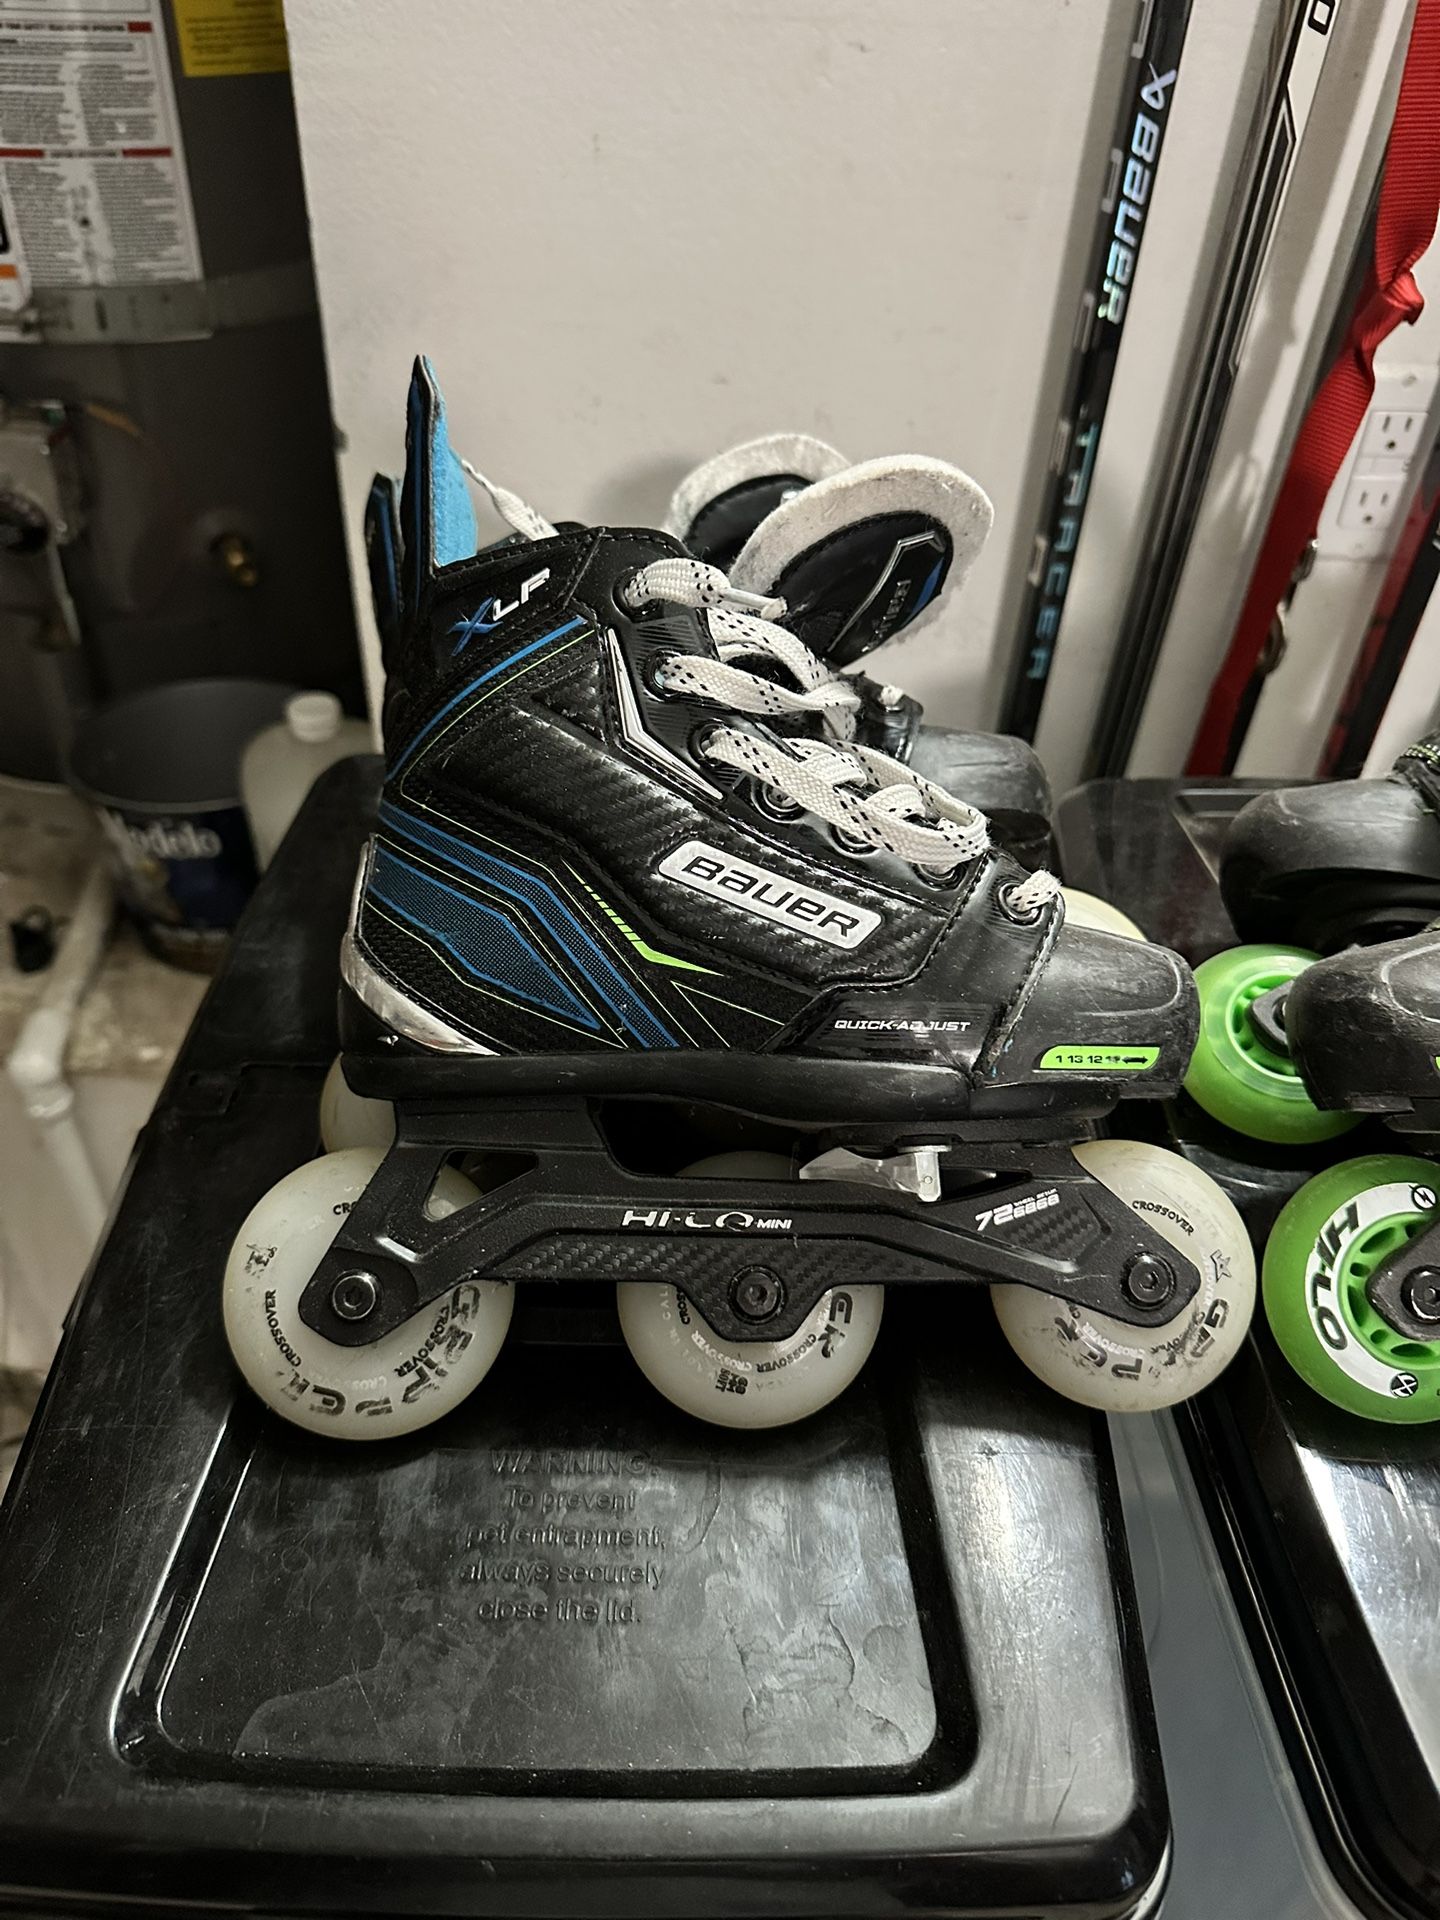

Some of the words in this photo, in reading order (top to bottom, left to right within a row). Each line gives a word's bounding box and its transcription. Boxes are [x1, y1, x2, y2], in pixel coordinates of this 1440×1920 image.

[1098, 112, 1160, 325] BAUER
[681, 854, 861, 937] BAUER
[834, 1020, 971, 1032] QUICK-ADJUST
[757, 1219, 792, 1230] MINI
[975, 1203, 1014, 1231] 72
[1132, 1200, 1195, 1236] CROSSOVER
[264, 1289, 302, 1367] CROSSOVER
[394, 1305, 450, 1378] CROSSOVER
[756, 1333, 817, 1373] CROSSOVER
[715, 1368, 731, 1392] SOFT
[506, 1485, 534, 1508] To
[541, 1489, 637, 1513] prevent
[465, 1519, 508, 1547] pet
[515, 1523, 665, 1552] entrapment,
[458, 1558, 550, 1586] always
[557, 1561, 665, 1590] securely
[477, 1597, 549, 1622] close
[556, 1597, 599, 1623] the
